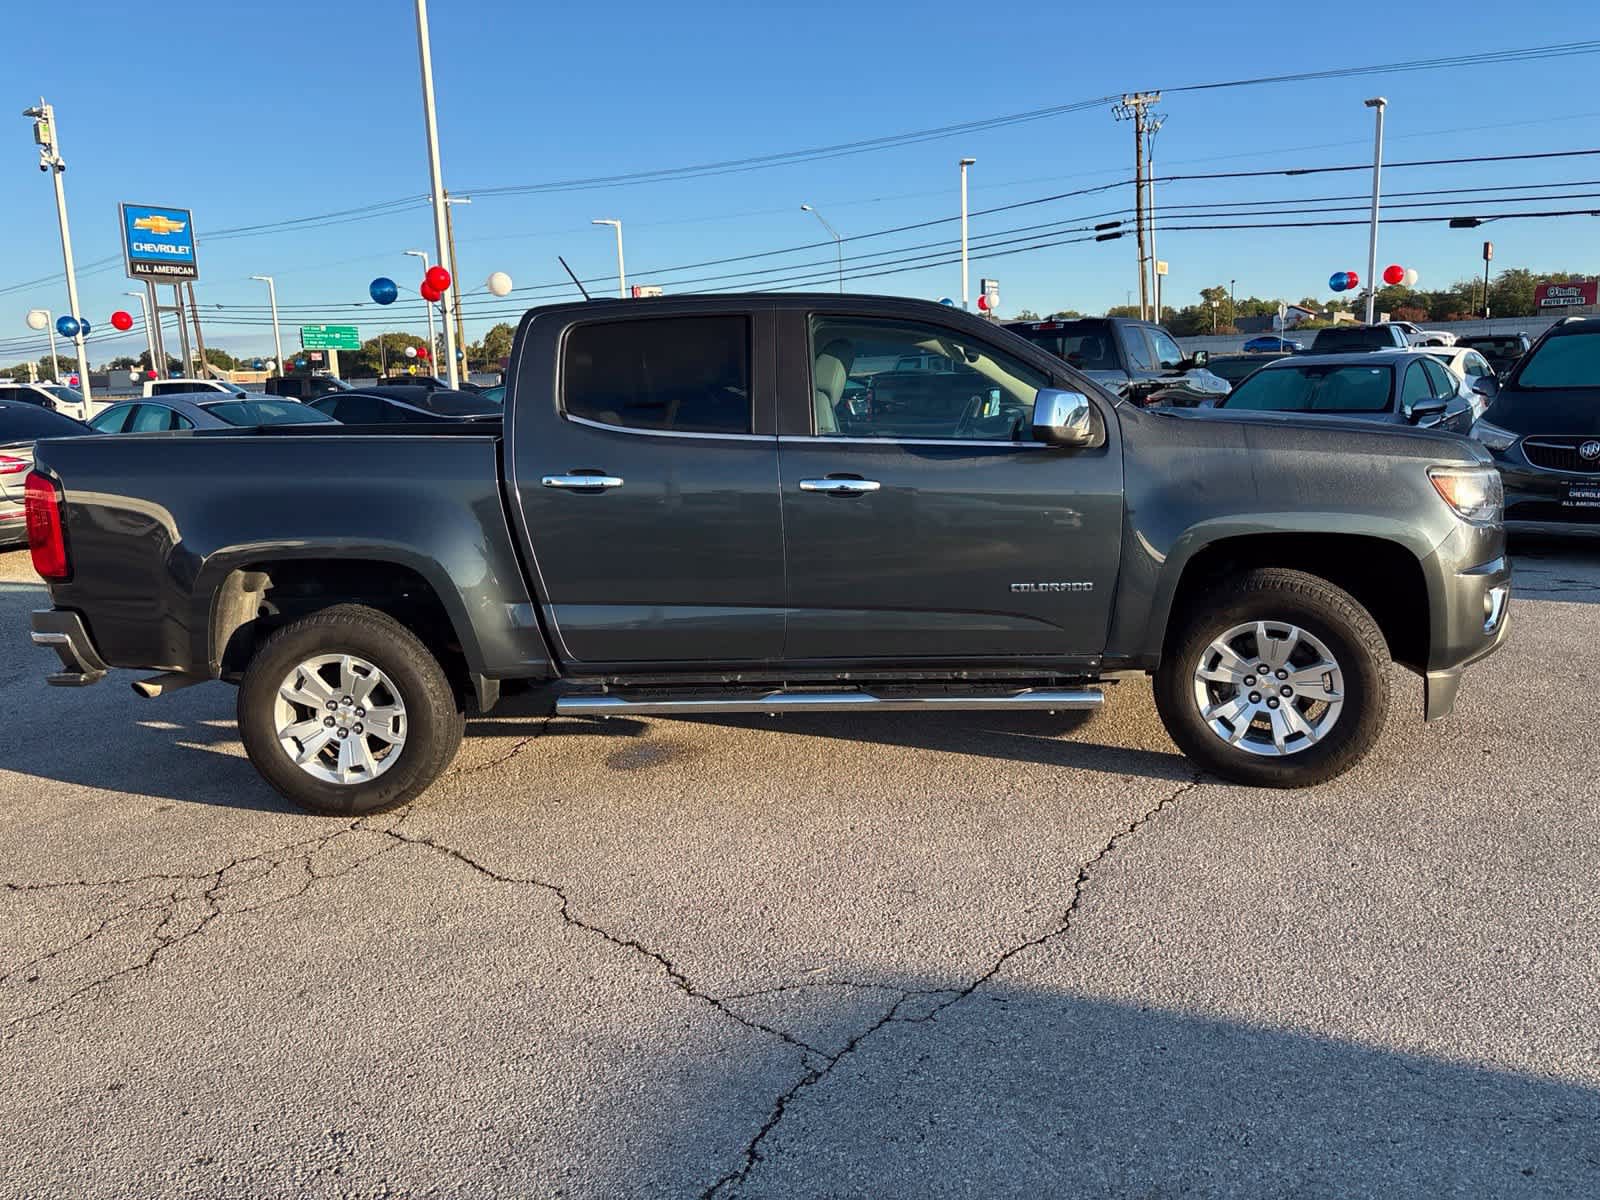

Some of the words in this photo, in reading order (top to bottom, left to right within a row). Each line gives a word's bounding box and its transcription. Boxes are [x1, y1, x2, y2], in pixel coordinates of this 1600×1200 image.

[133, 242, 190, 254] CHEVROLET
[136, 264, 151, 273] ALL
[153, 265, 194, 275] AMERICAN
[1010, 582, 1094, 593] COLORADO
